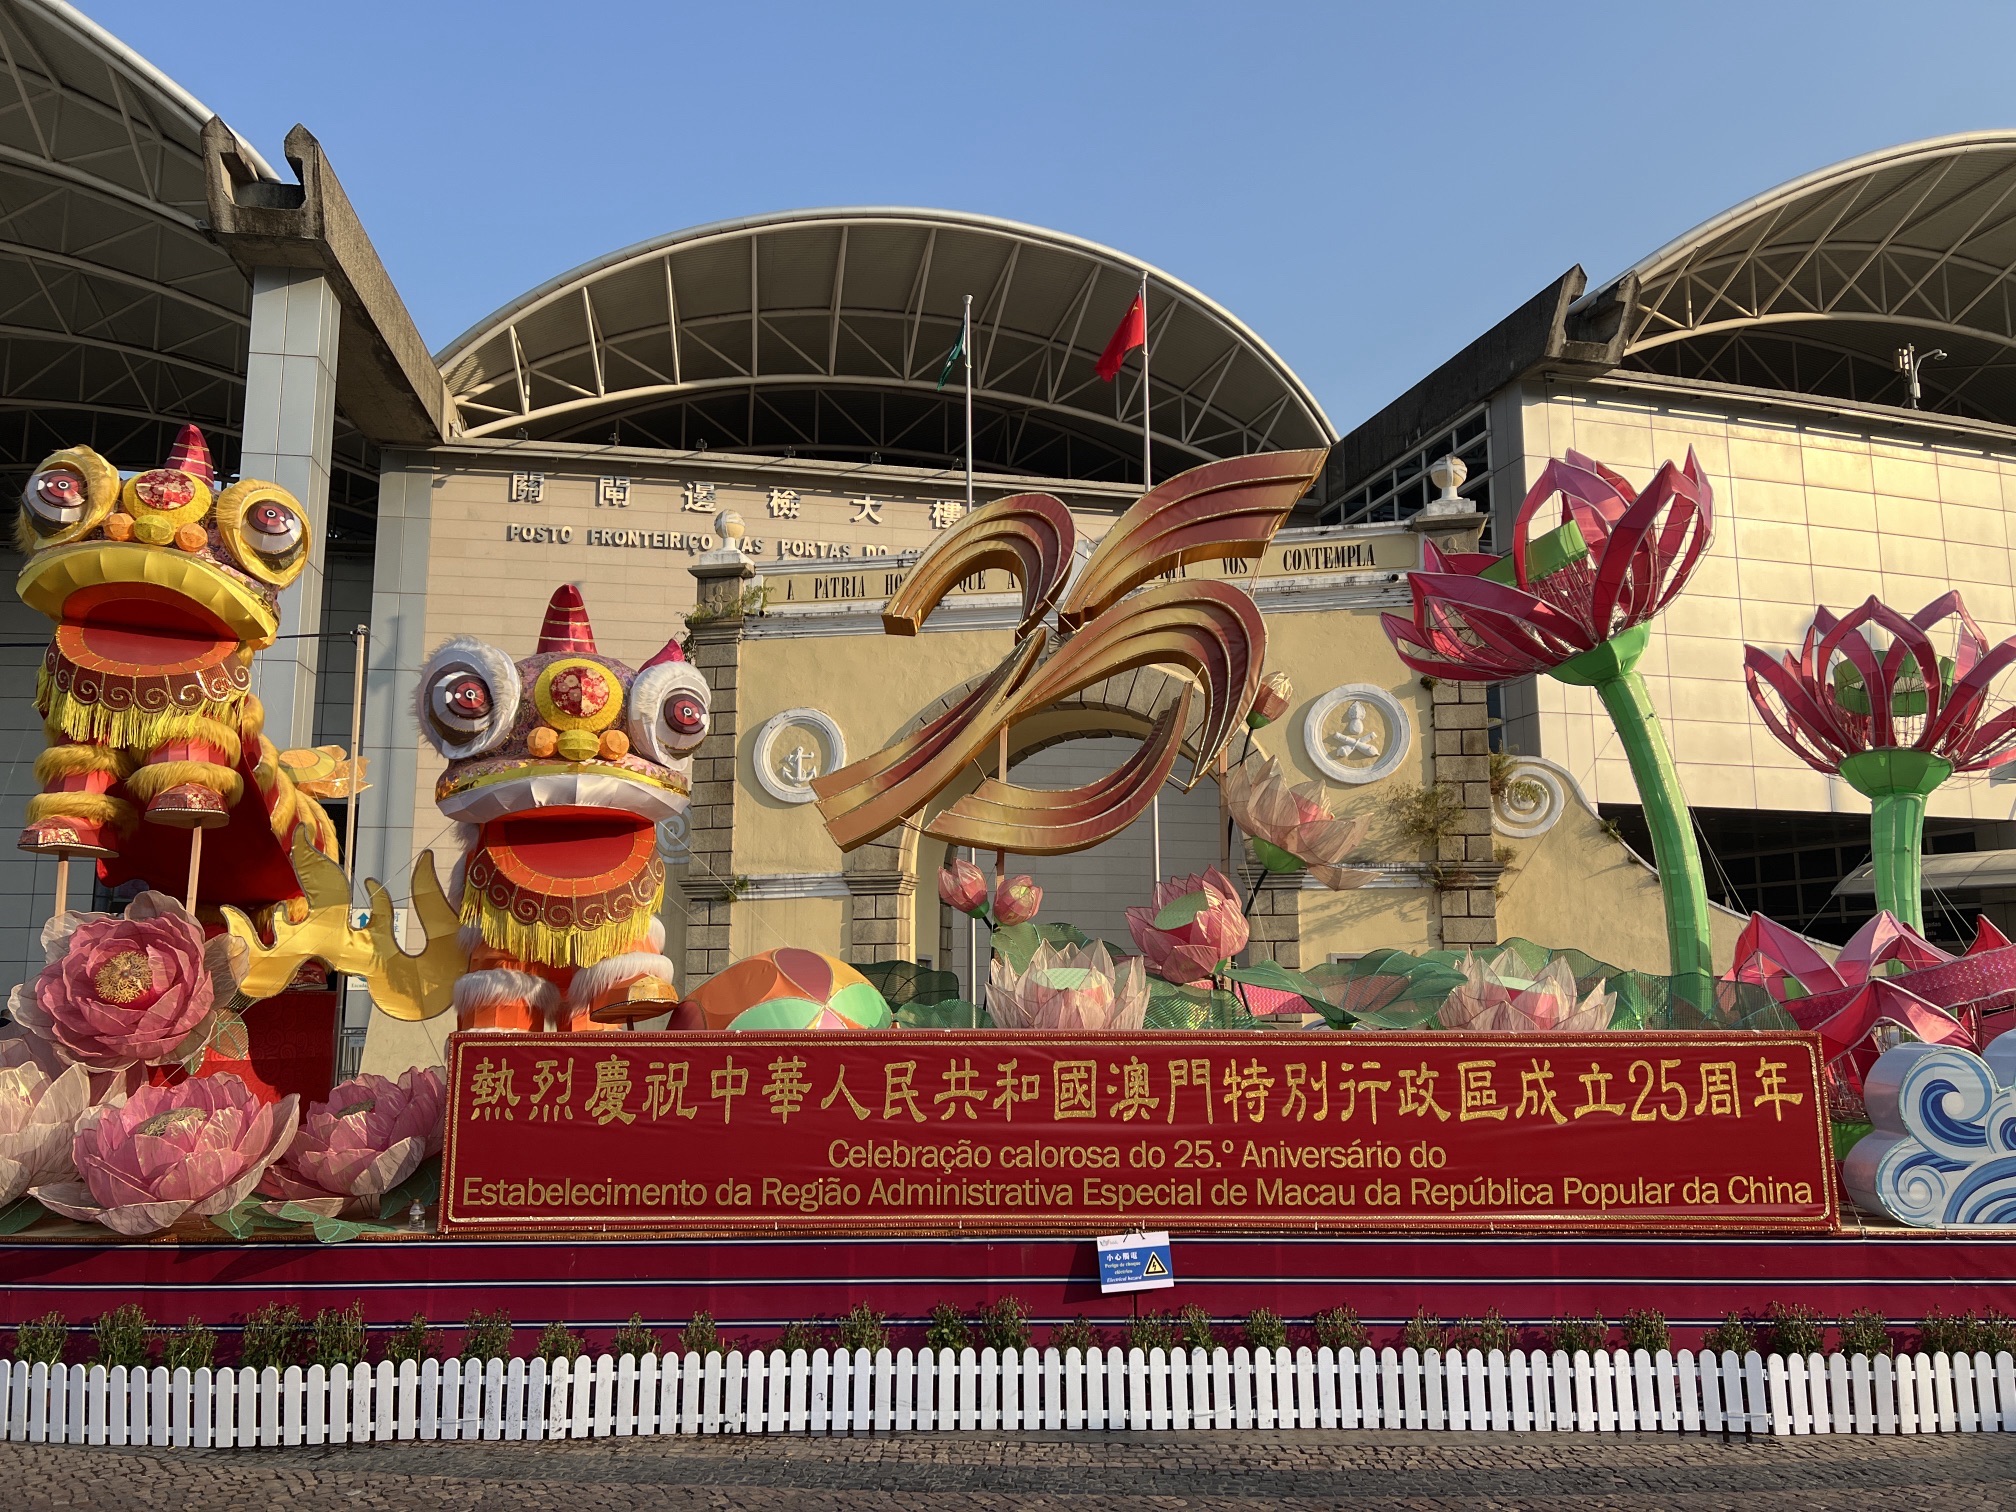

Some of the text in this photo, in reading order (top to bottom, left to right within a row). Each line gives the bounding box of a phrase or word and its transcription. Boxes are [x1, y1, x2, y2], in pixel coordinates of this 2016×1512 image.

[508, 523, 888, 558] POSTO FRONTEIRIÇO AS PORTAS DO
[787, 579, 795, 600] A
[814, 574, 866, 599] PÁTRIA
[1222, 557, 1248, 575] VOS
[1283, 544, 1376, 571] CONTEMPLA
[469, 1054, 1804, 1126] 熱烈慶祝中華人民共和國澳門特別行政區成立25周年
[828, 1139, 991, 1174] Celebração
[1000, 1140, 1121, 1168] calorosa
[1129, 1140, 1166, 1169] do
[1241, 1138, 1402, 1169] Aniversário
[1409, 1140, 1447, 1169] do
[462, 1175, 1814, 1212] Estabelecimento da Região Administrativa Especial de Macau da República Popular da China
